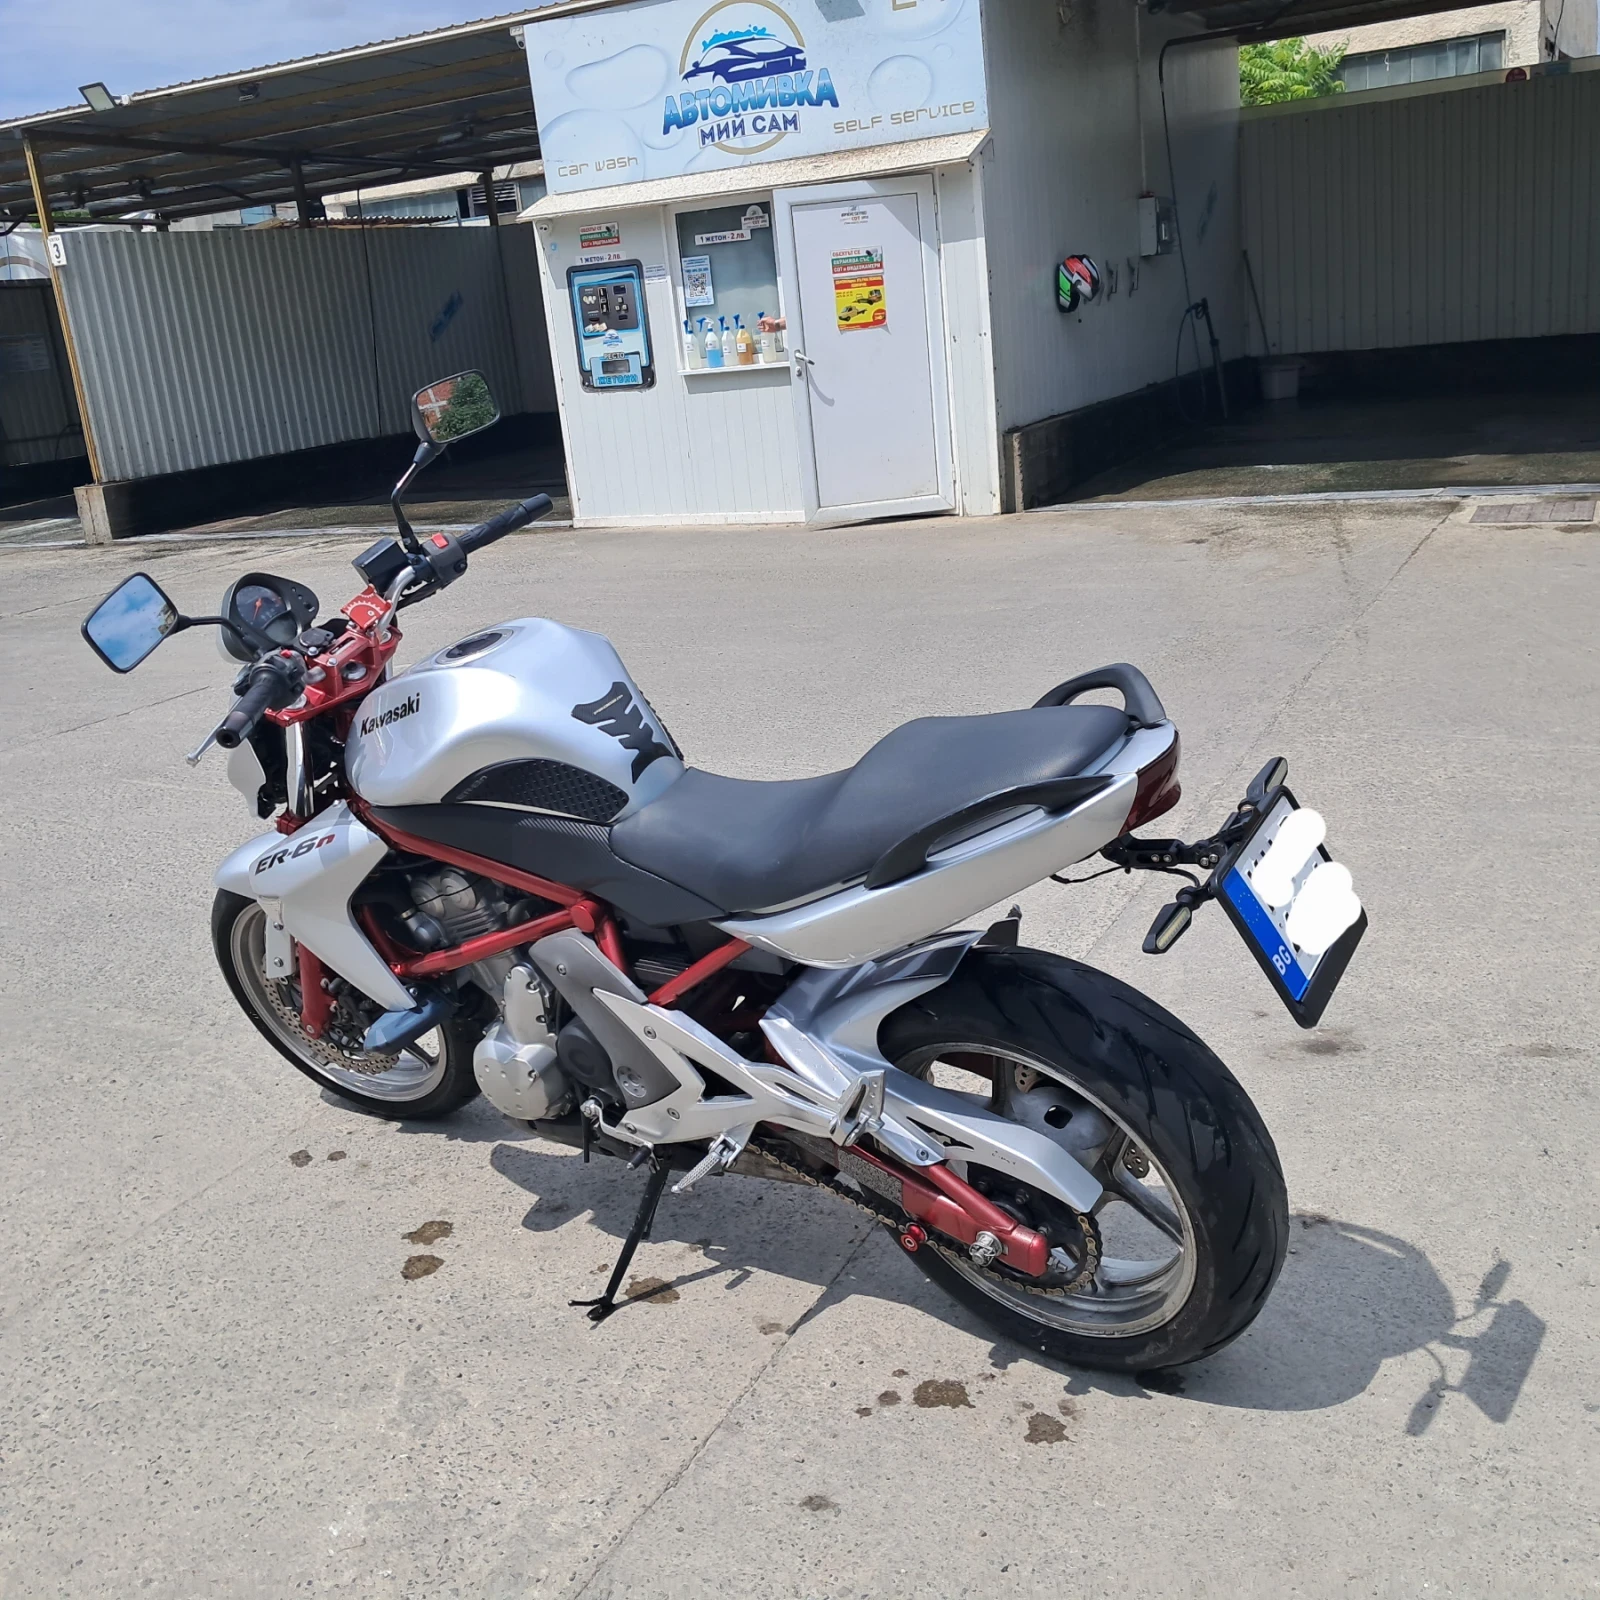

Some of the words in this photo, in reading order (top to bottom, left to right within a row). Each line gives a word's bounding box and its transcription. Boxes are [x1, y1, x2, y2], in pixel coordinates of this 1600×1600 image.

[663, 68, 839, 135] АВТОМИВКА
[700, 114, 746, 146] МИЙ
[752, 113, 798, 134] САМ
[558, 163, 589, 177] car
[595, 156, 638, 172] wash
[705, 234, 727, 243] ЖЕТОН
[731, 232, 735, 240] 2
[53, 243, 61, 259] 3
[584, 255, 604, 263] ЖЕТОН
[604, 352, 625, 360] РЕСТО
[360, 692, 420, 738] Kawasaki
[255, 834, 335, 876] ER-6n
[1272, 945, 1291, 976] BG
